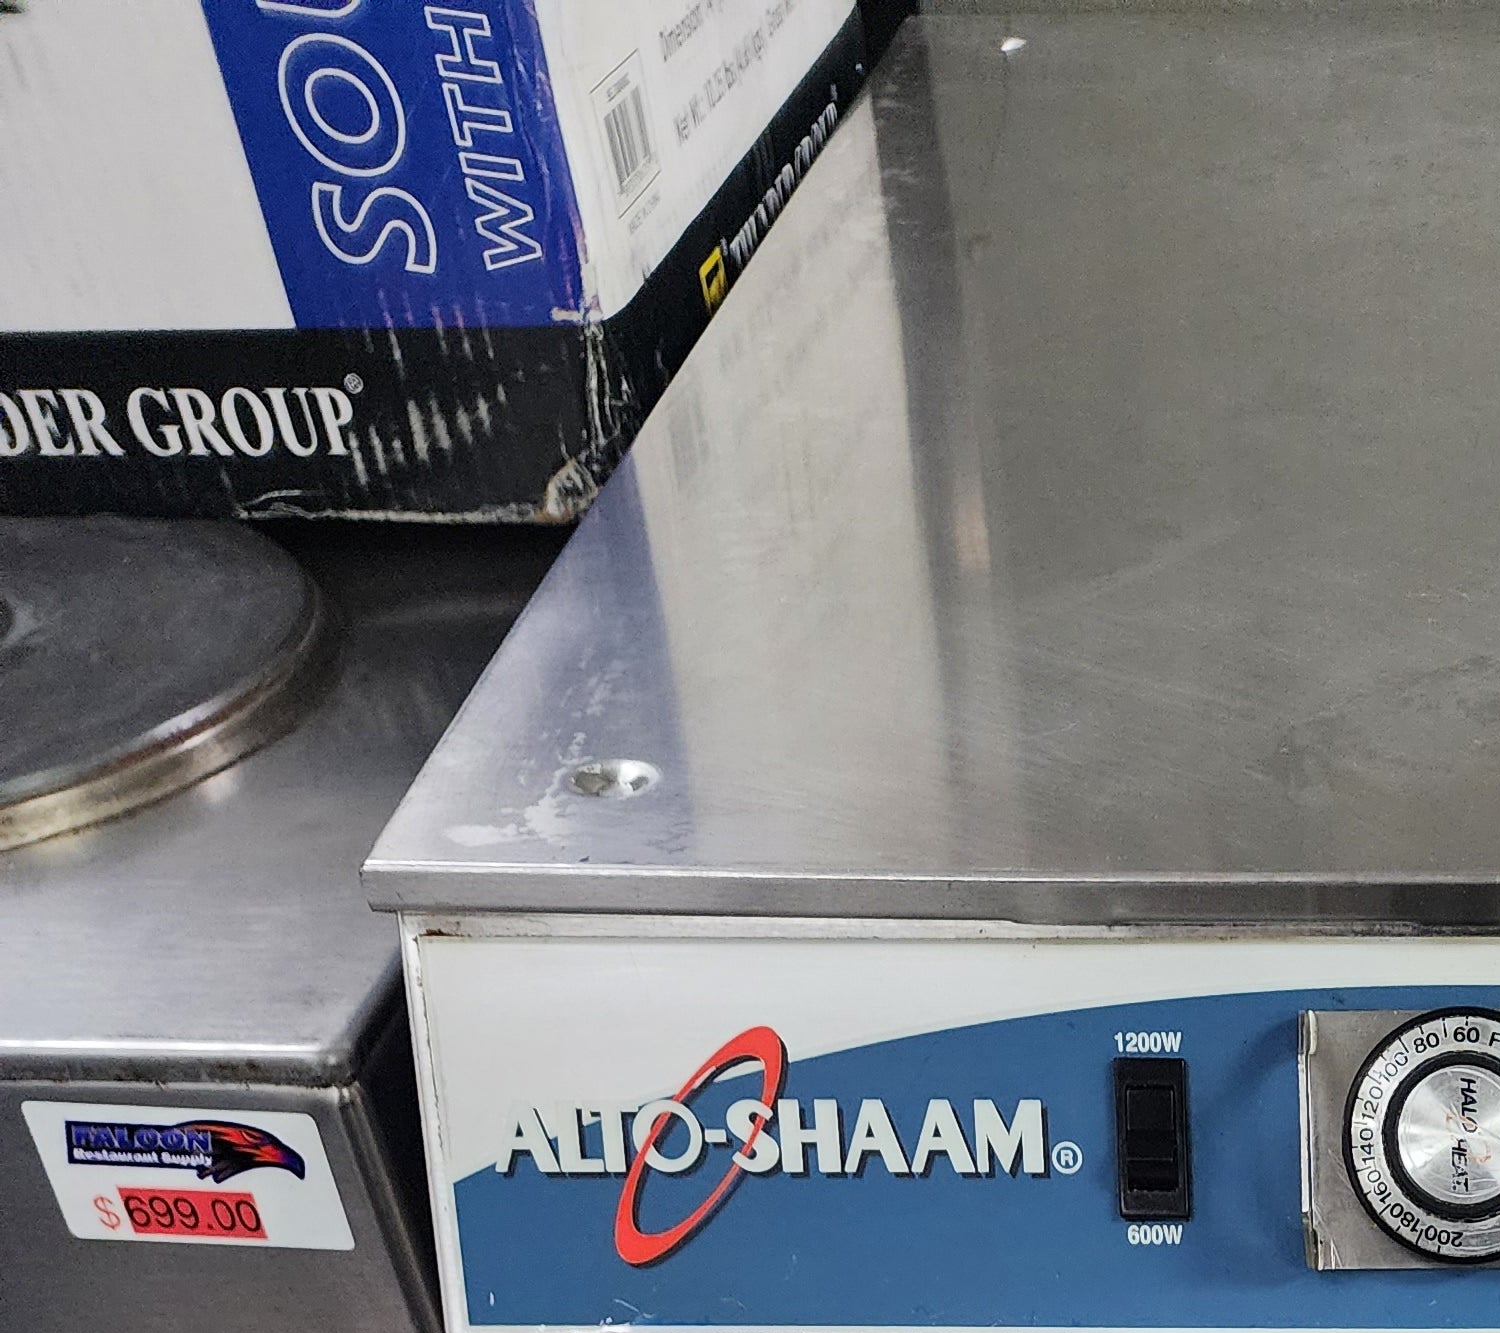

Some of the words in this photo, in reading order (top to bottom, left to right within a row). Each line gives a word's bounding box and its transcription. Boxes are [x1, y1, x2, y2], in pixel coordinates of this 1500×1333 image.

[424, 5, 543, 272] WITH
[1114, 1031, 1183, 1054] 1200W
[1412, 1031, 1441, 1054] 80
[1452, 1026, 1481, 1044] 60
[1380, 1051, 1410, 1084] 100
[1361, 1085, 1385, 1122] 120
[1459, 1077, 1478, 1134] HALO
[73, 1148, 160, 1164] Restaurant
[161, 1151, 213, 1167] Supply
[1362, 1127, 1375, 1165] 140
[1366, 1166, 1393, 1205] 160
[1389, 1201, 1420, 1235] 180
[1127, 1223, 1183, 1247] 600W
[1424, 1228, 1464, 1248] 200
